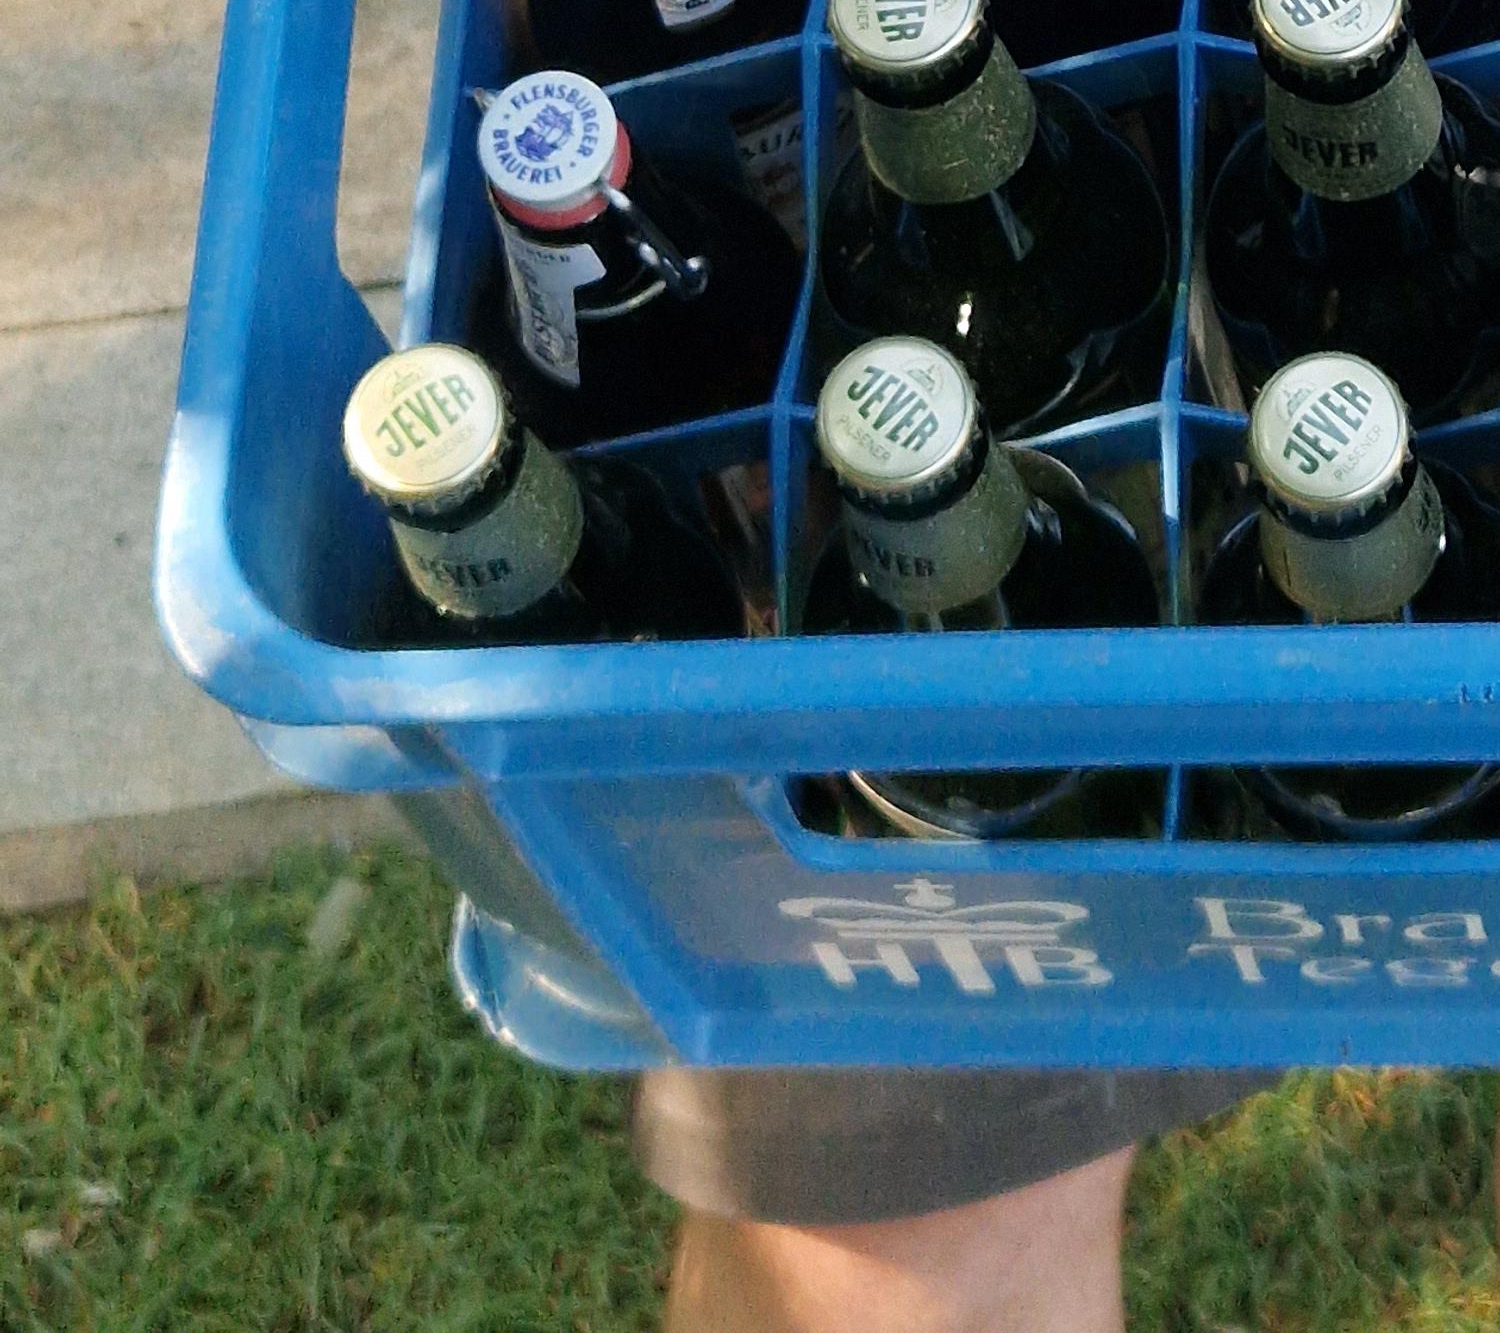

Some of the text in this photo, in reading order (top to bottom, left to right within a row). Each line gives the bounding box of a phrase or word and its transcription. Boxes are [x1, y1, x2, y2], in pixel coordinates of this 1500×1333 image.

[493, 129, 563, 184] BRAUEREI
[510, 84, 600, 157] FLENSBURGER
[376, 373, 476, 458] JEVER
[838, 414, 892, 462] PILSENER
[847, 365, 940, 453] JEVER
[1283, 379, 1373, 476] JEVER
[1333, 425, 1383, 482] PILSENER
